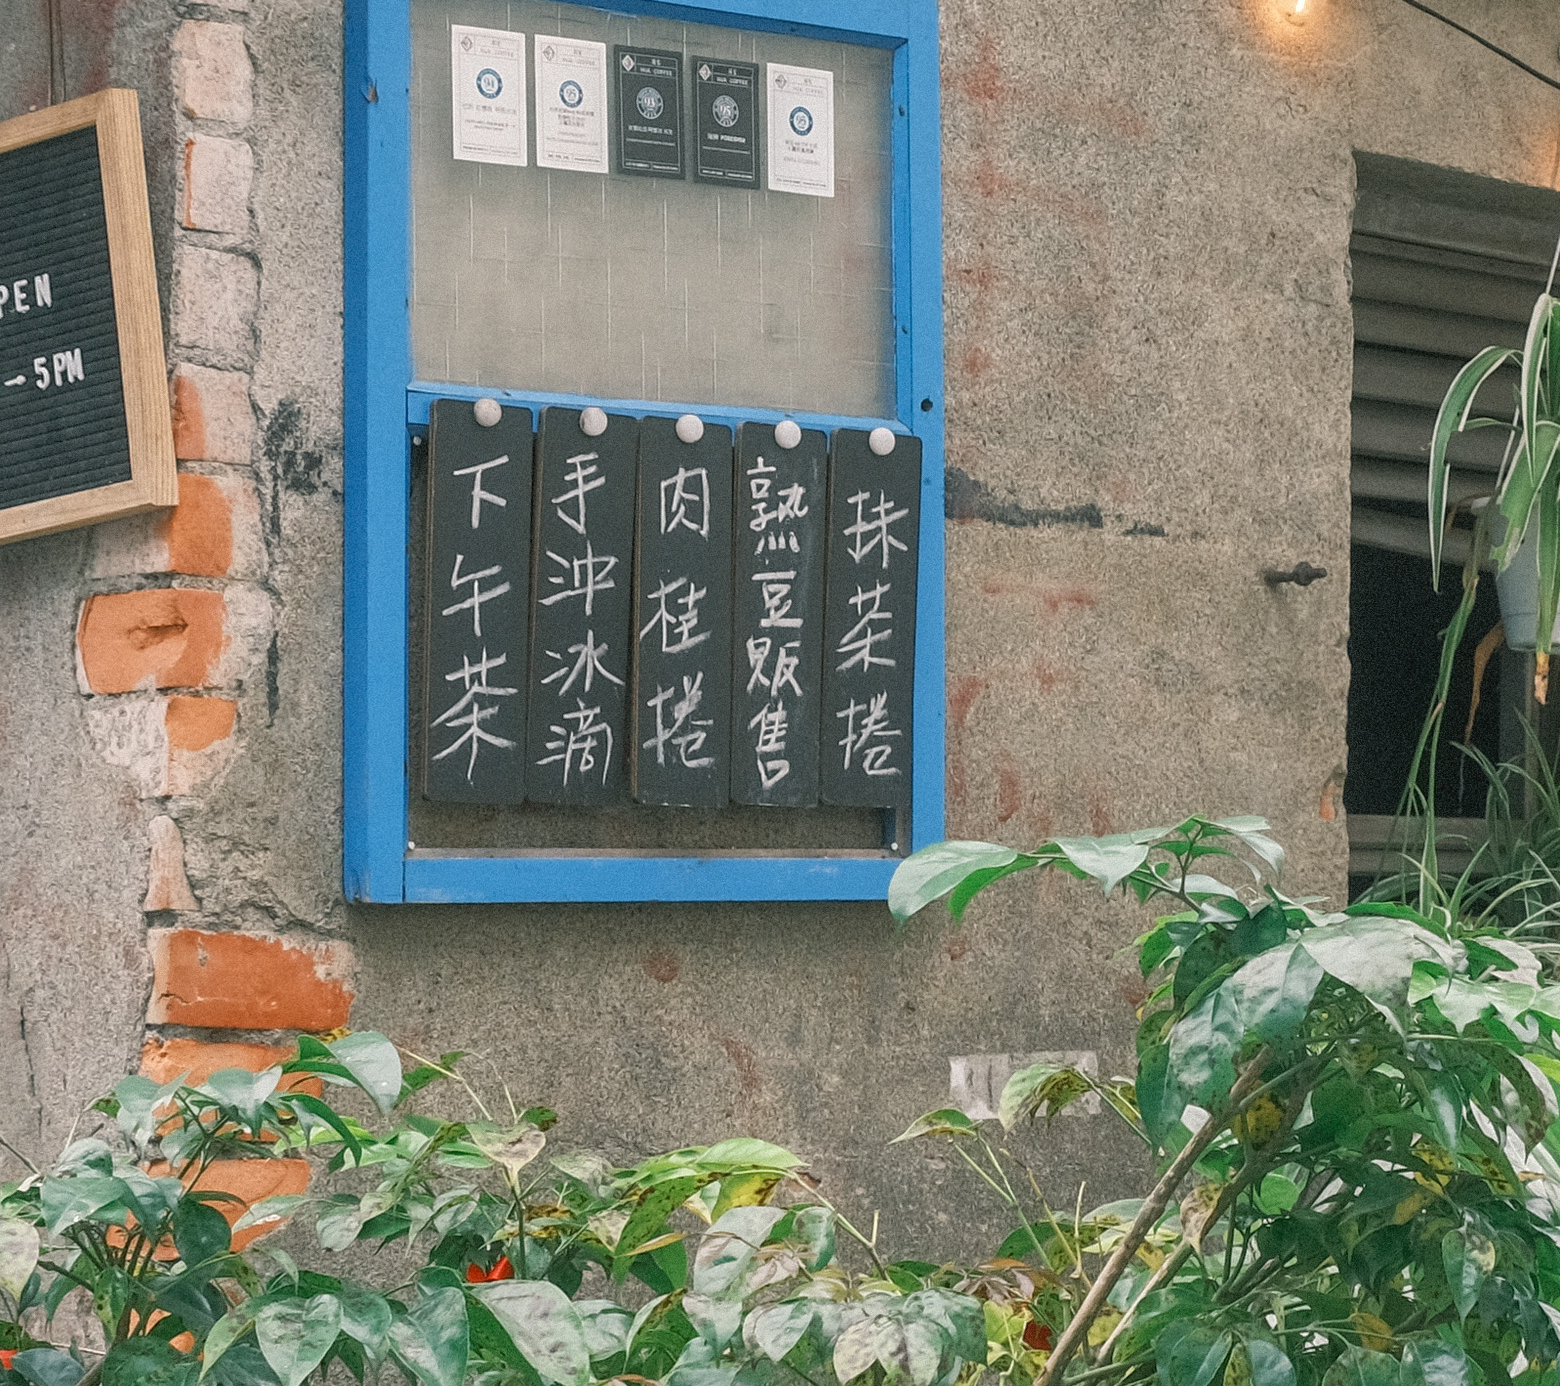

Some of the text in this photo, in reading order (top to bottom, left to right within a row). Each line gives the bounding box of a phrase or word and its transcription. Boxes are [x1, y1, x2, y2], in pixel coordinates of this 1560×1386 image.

[430, 454, 518, 786] 下午茶
[639, 466, 716, 770] 肉桂捲
[746, 456, 809, 790] 熟豆販售
[836, 489, 910, 776] 抹茶捲
